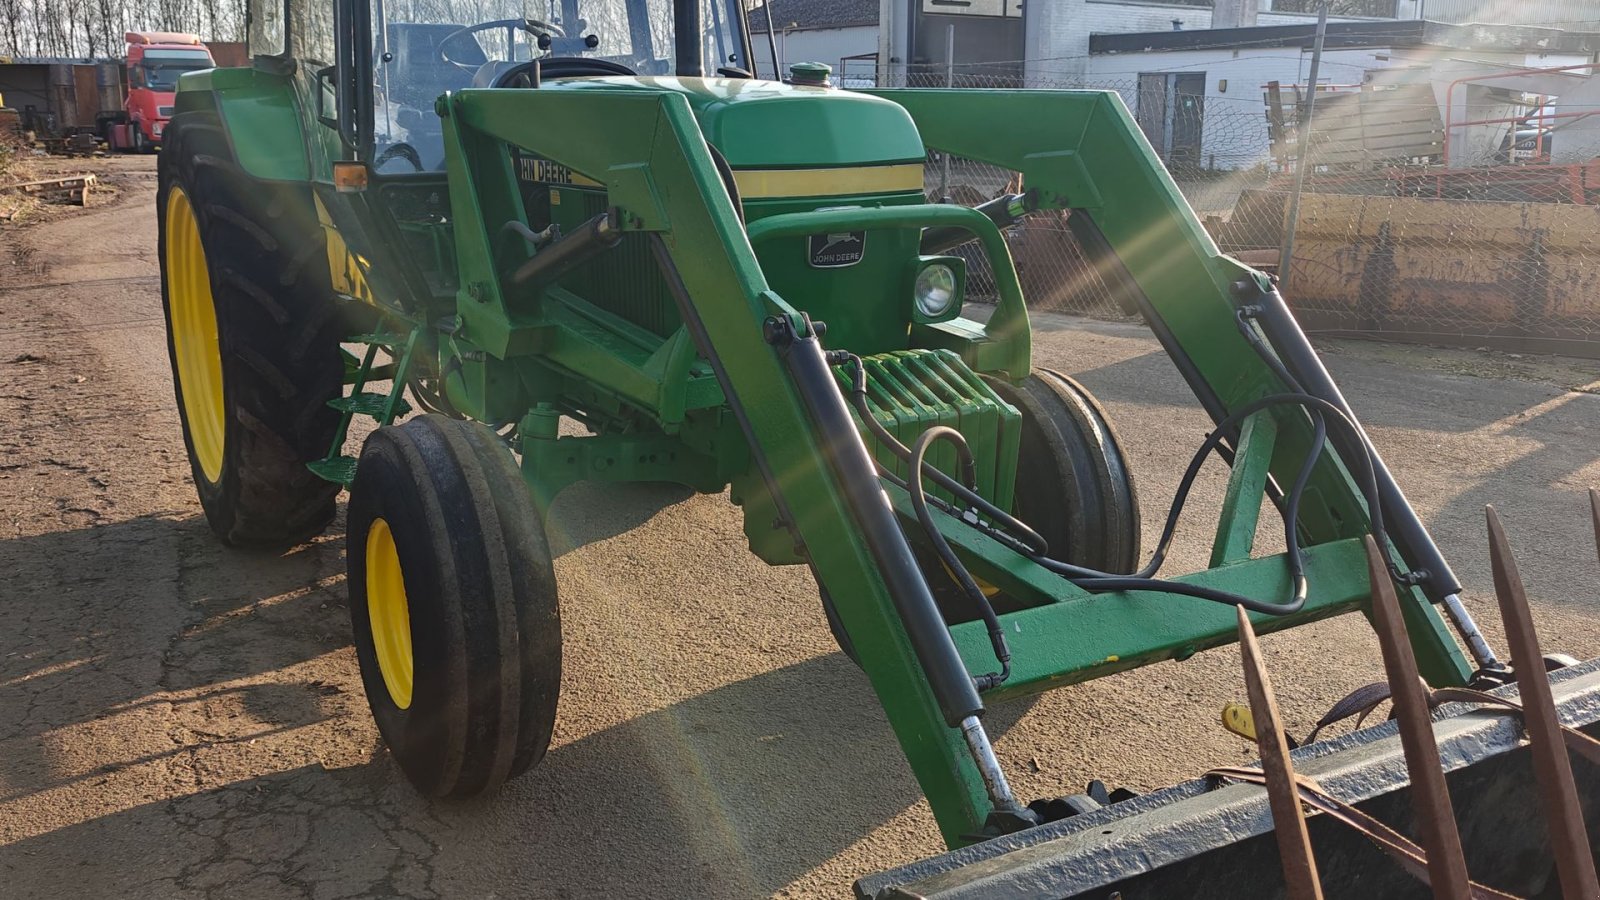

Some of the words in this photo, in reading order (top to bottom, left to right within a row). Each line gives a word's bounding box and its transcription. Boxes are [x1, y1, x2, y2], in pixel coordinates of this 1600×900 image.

[519, 158, 535, 181] HN
[538, 159, 572, 183] DEERE
[813, 255, 834, 263] JOHN
[836, 252, 860, 261] DEERE
